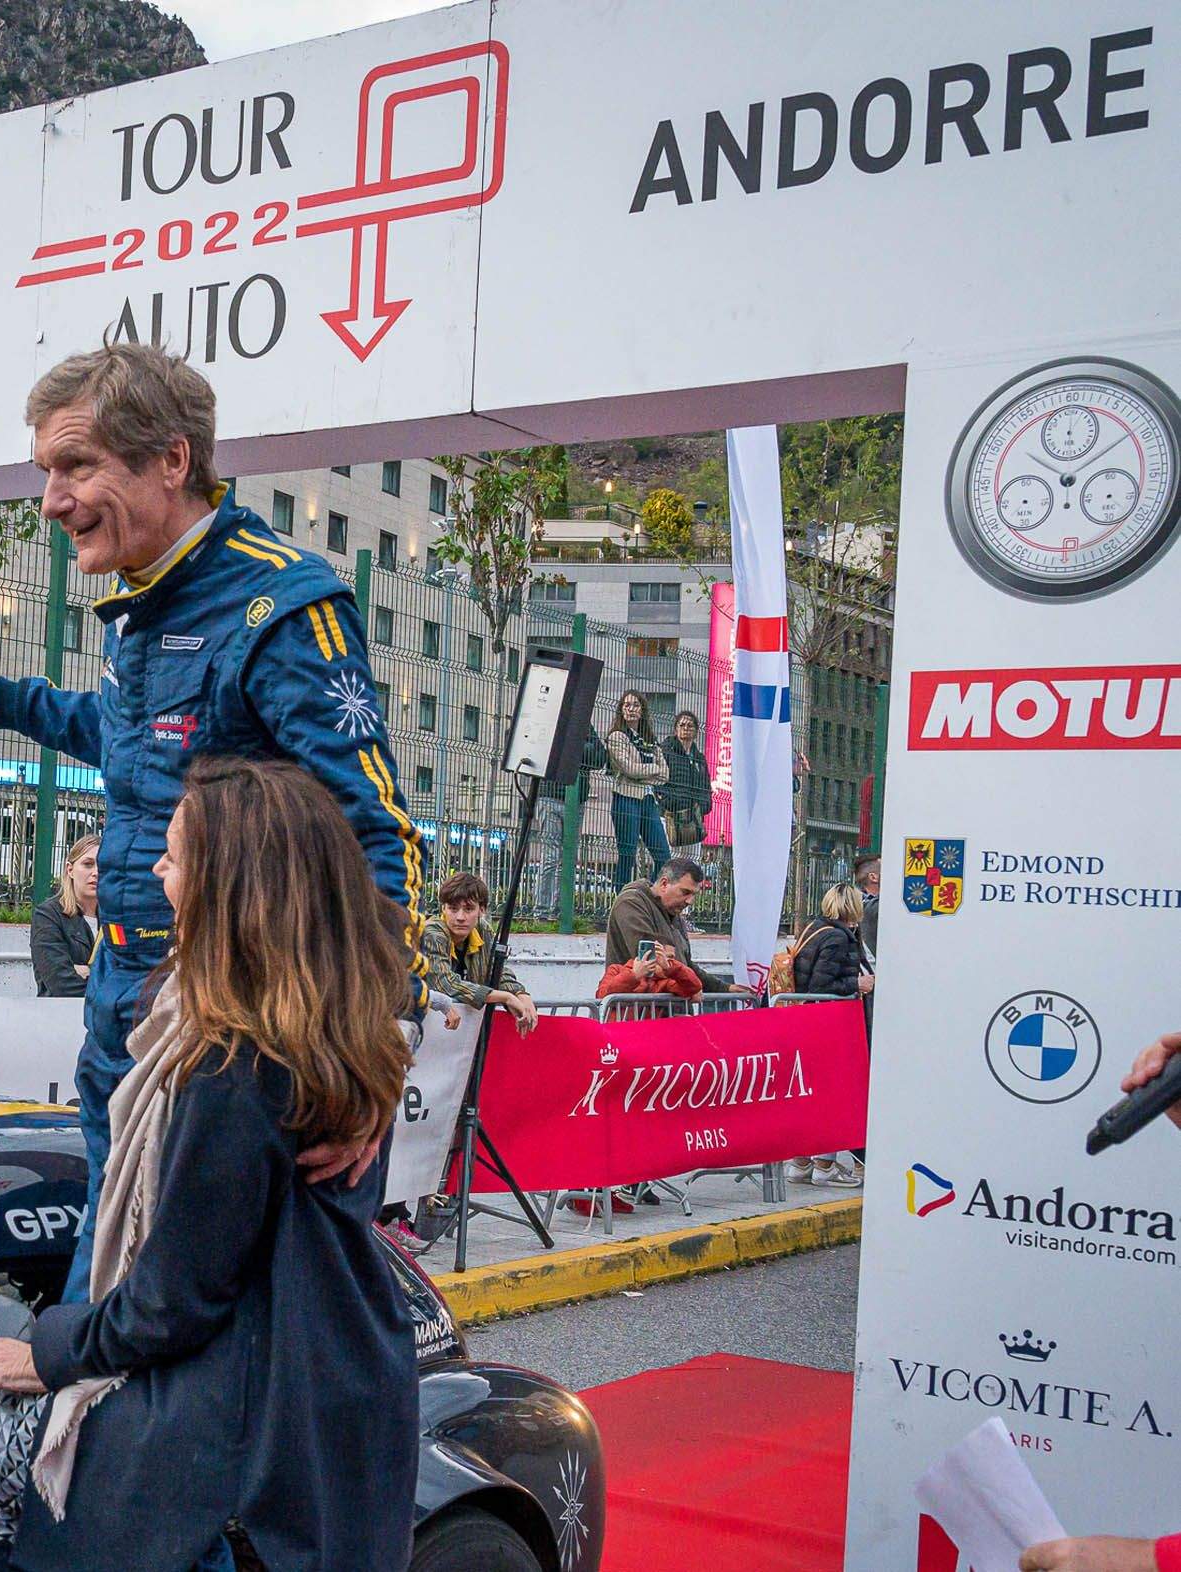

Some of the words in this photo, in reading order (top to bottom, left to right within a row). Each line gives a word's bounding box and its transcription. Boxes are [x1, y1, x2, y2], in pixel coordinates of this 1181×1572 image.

[629, 27, 1153, 213] ANDORRE
[112, 91, 295, 202] TOUR
[111, 201, 290, 271] 2022
[981, 850, 1104, 875] EDMOND
[980, 883, 1016, 902] DE
[1002, 996, 1087, 1028] BMW
[624, 1052, 780, 1113] VICOMTE
[685, 1127, 728, 1151] PARIS
[962, 1178, 1177, 1241] Andorra
[1005, 1229, 1176, 1265] visitandorra.com
[888, 1357, 1111, 1427] VICOMTE
[1009, 1431, 1053, 1453] RIS
